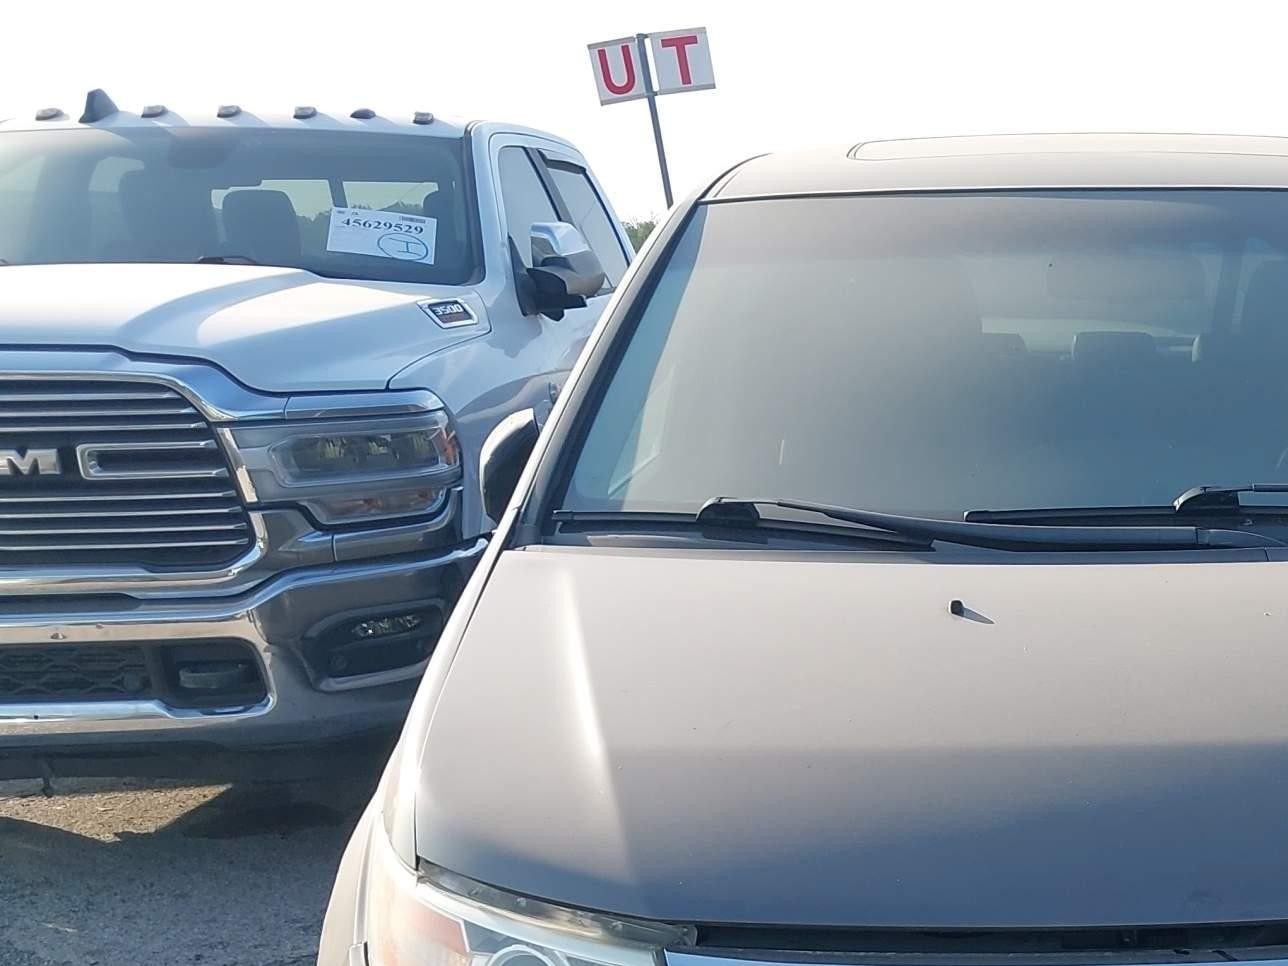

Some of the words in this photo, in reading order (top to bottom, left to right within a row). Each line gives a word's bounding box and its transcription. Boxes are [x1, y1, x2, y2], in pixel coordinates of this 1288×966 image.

[597, 44, 636, 95] U
[660, 35, 698, 85] T
[341, 218, 425, 235] 45629529
[432, 303, 464, 316] 3500
